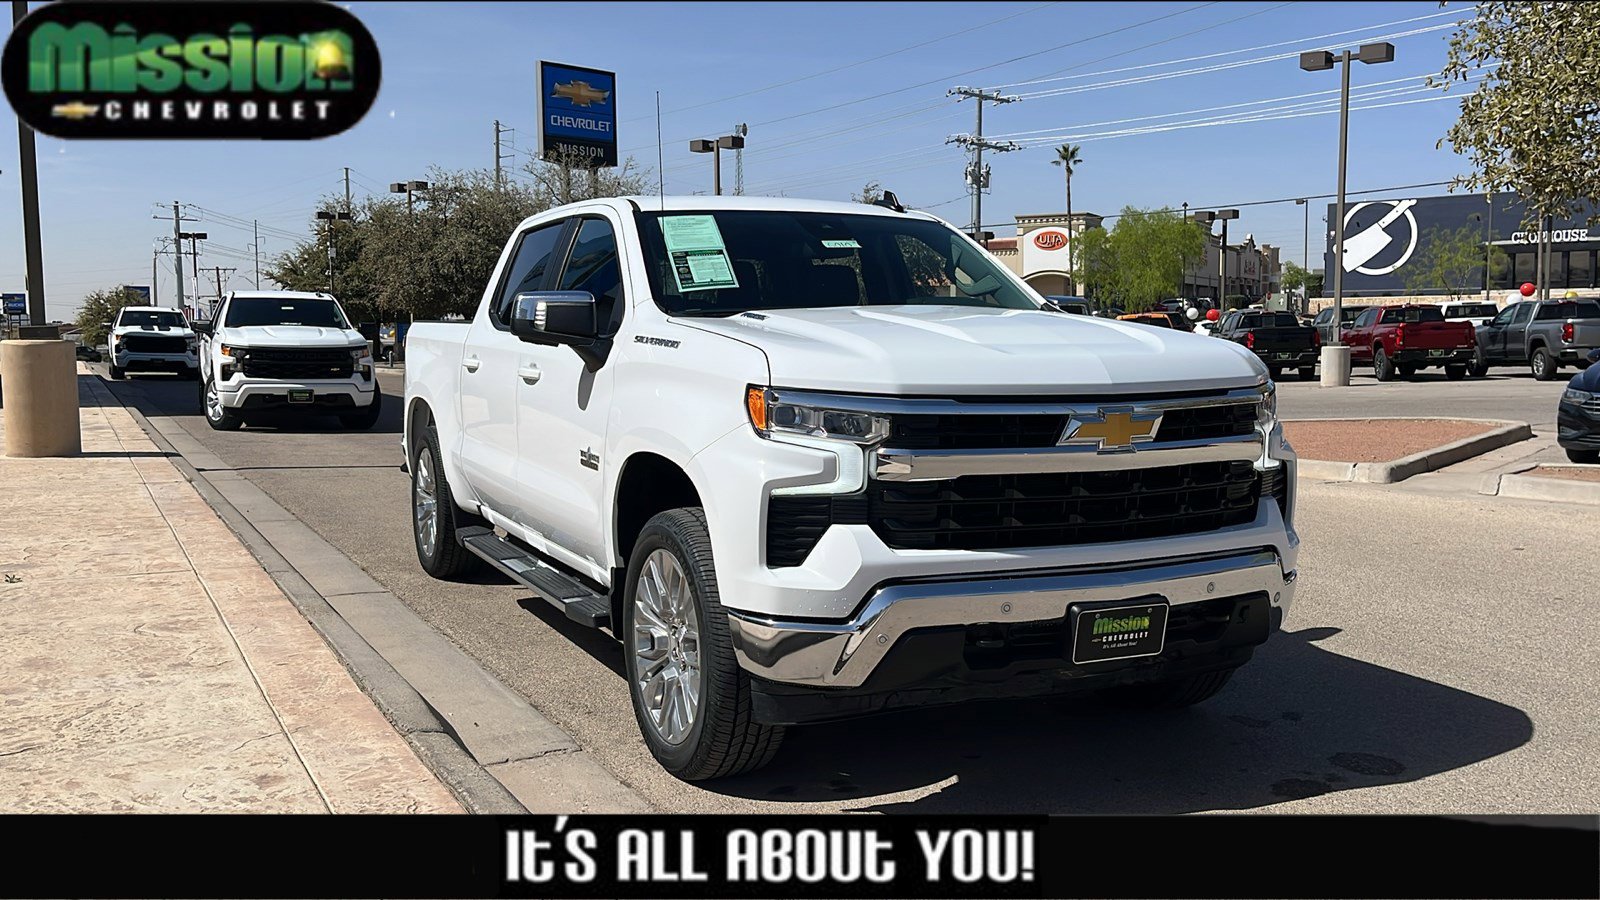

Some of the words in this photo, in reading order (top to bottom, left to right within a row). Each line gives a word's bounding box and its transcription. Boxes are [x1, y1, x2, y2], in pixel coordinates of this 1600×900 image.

[550, 115, 611, 132] CHEVROLET
[558, 142, 605, 158] MISSION
[1039, 233, 1063, 247] ULTA
[1103, 632, 1148, 642] CHEVROLET
